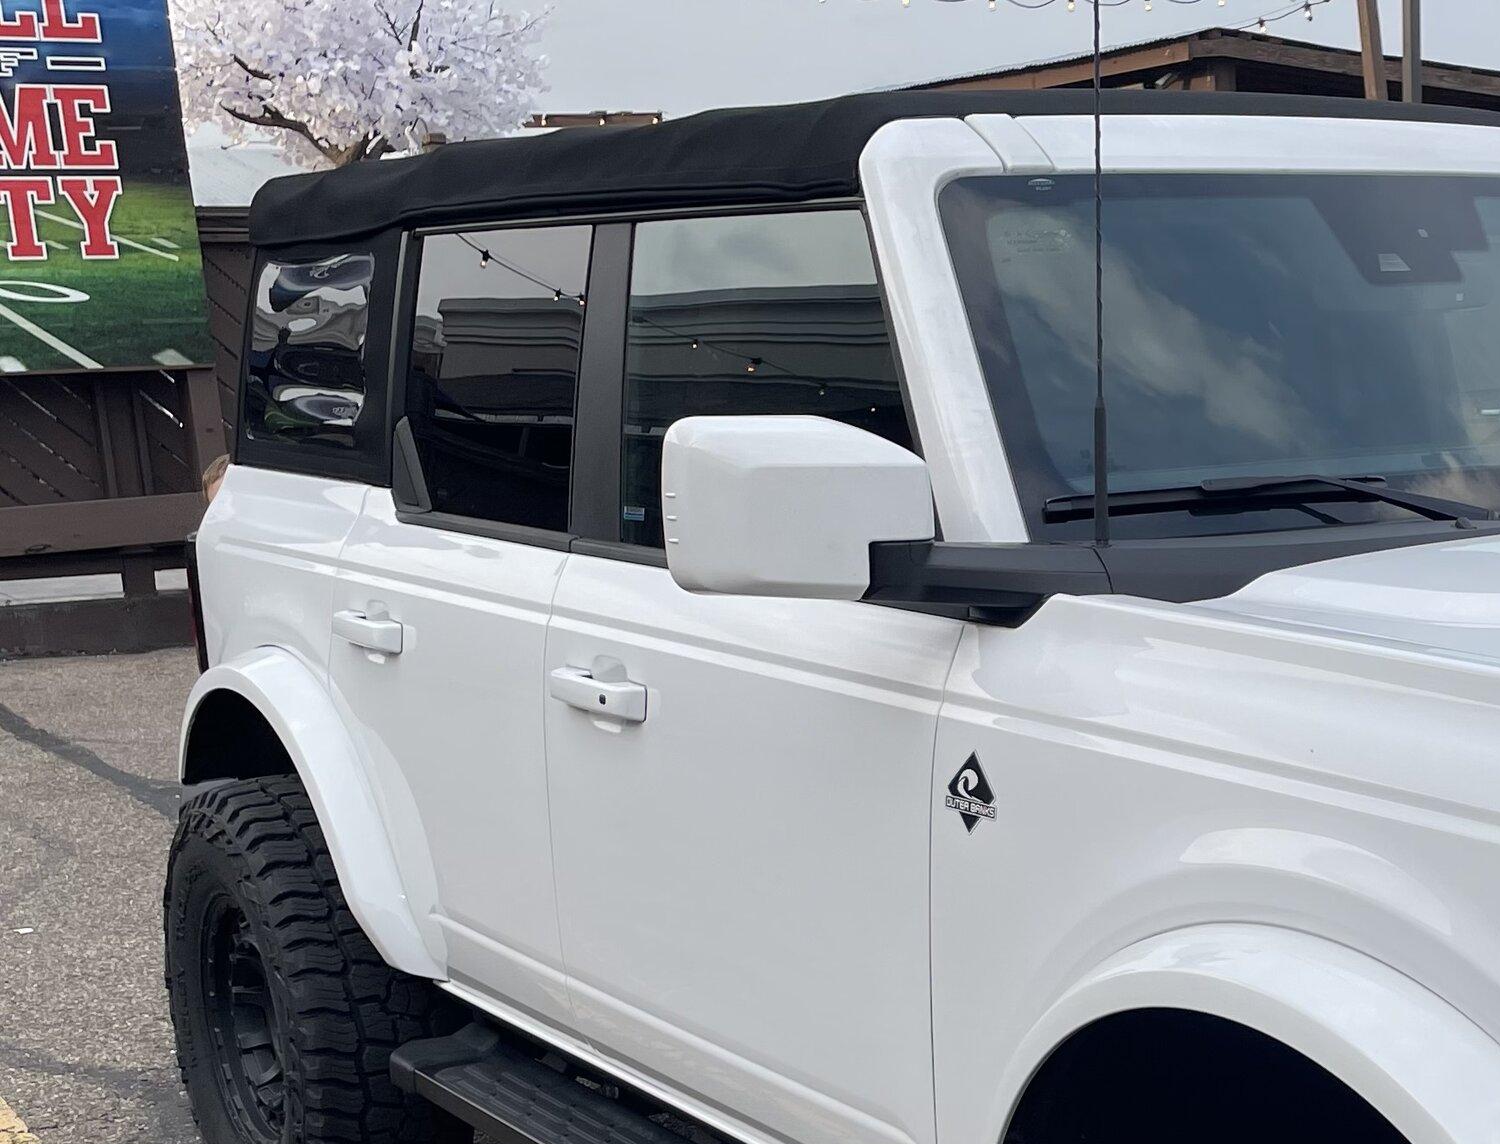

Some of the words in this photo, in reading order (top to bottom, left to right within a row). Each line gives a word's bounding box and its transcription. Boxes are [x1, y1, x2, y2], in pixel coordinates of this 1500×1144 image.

[0, 176, 123, 260] TY
[946, 797, 970, 812] OUTER
[970, 803, 995, 819] BANKS
